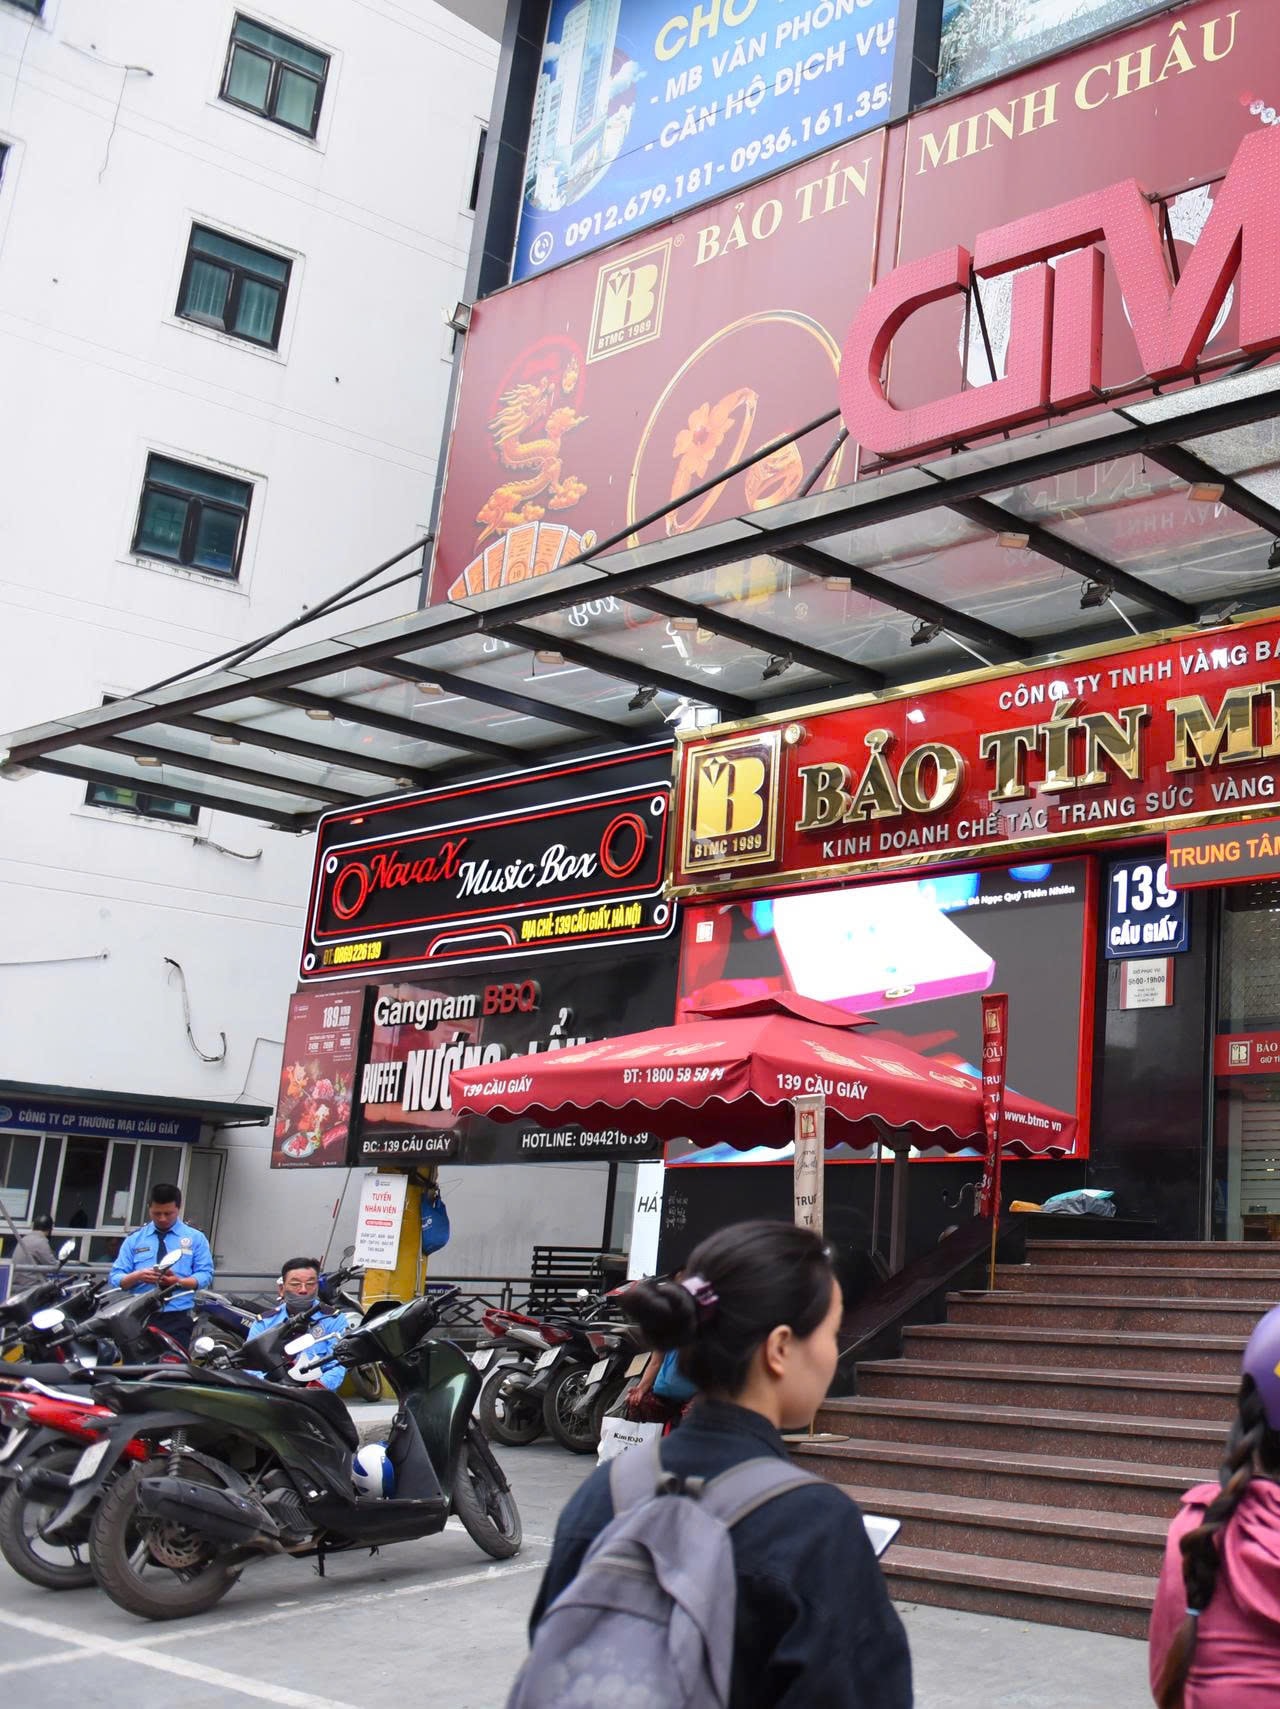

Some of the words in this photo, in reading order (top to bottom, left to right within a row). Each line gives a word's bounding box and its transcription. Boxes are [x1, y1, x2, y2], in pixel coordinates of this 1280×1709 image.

[660, 102, 717, 148] CĂN
[724, 74, 766, 115] HỘ
[774, 42, 846, 96] DỊCH
[855, 17, 895, 56] VỤ
[665, 65, 703, 103] MB
[711, 32, 767, 79] VĂN
[693, 202, 783, 267] BẢO
[795, 157, 872, 224] TÍN
[915, 82, 1059, 175] MINH
[1075, 10, 1241, 111] CHÂU
[731, 81, 892, 173] 0936.161.35
[597, 330, 624, 350] BTMC
[627, 319, 652, 341] 1989
[999, 682, 1068, 711] CÔNG
[1074, 673, 1101, 695] TY
[1108, 660, 1172, 689] TNHH
[1180, 645, 1248, 676] VÀNG
[795, 729, 967, 833] BẢO
[980, 699, 1149, 803] TÍN
[823, 834, 871, 859] KINH
[880, 824, 949, 851] DOANH
[957, 807, 1001, 841] CHẾ
[1008, 802, 1049, 833] TÁC
[1058, 796, 1135, 825] TRANG
[1145, 785, 1195, 814] SỨC
[1211, 774, 1275, 803] VÀNG
[694, 840, 727, 858] BTMC
[733, 835, 762, 852] 1989
[1170, 840, 1241, 869] TRUNG
[456, 859, 536, 899] Music
[537, 843, 598, 887] Box
[1113, 863, 1177, 914] 139
[1111, 920, 1139, 947] CẦU
[1143, 915, 1178, 944] GIẤY
[374, 994, 476, 1031] Gangnam
[483, 980, 538, 1016] BBQ
[1256, 1041, 1278, 1053] BẢO
[361, 1061, 402, 1104] BUFFET
[402, 1032, 501, 1112] NƯỚ
[483, 1080, 506, 1095] CẦU
[508, 1074, 533, 1094] GIẤY
[624, 1069, 642, 1083] ĐT:
[646, 1068, 673, 1082] 1800
[677, 1068, 692, 1082] 58
[694, 1067, 709, 1081] 58
[776, 1074, 801, 1090] 139
[804, 1075, 834, 1095] CẦU
[837, 1080, 868, 1100] GIẤY
[19, 1109, 46, 1123] CÔNG
[49, 1113, 60, 1125] TY
[62, 1115, 76, 1127] CP
[78, 1116, 115, 1130] THƯƠNG
[117, 1119, 135, 1133] MẠI
[137, 1119, 156, 1133] CẦU
[158, 1120, 179, 1135] GIẤY
[522, 1132, 576, 1148] HOTLINE:
[383, 1140, 400, 1153] 139
[401, 1135, 424, 1151] CẦU
[425, 1133, 451, 1150] GIẤY
